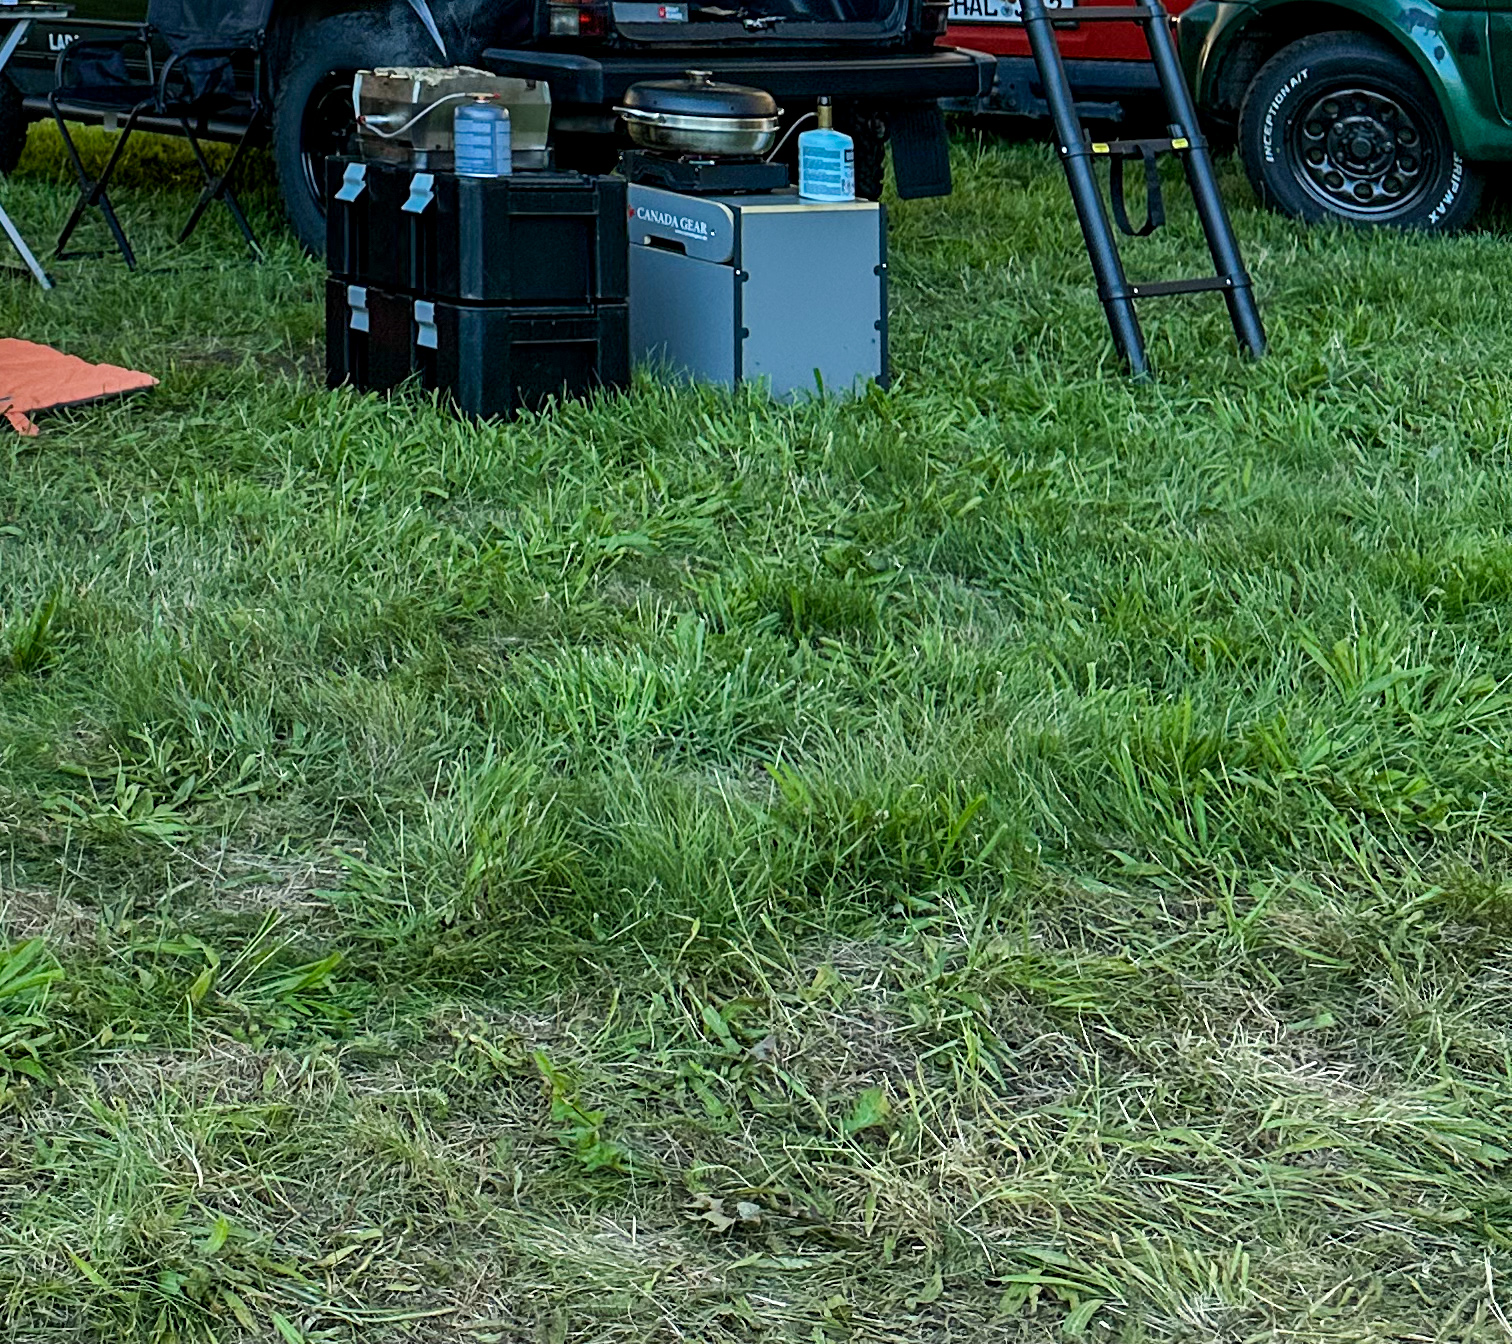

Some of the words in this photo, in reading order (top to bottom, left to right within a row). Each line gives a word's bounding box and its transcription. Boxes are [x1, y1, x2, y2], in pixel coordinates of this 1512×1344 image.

[1263, 83, 1291, 163] INCEPTION
[1289, 67, 1308, 89] A/T
[636, 206, 679, 229] CANADA
[679, 216, 708, 235] GEAR
